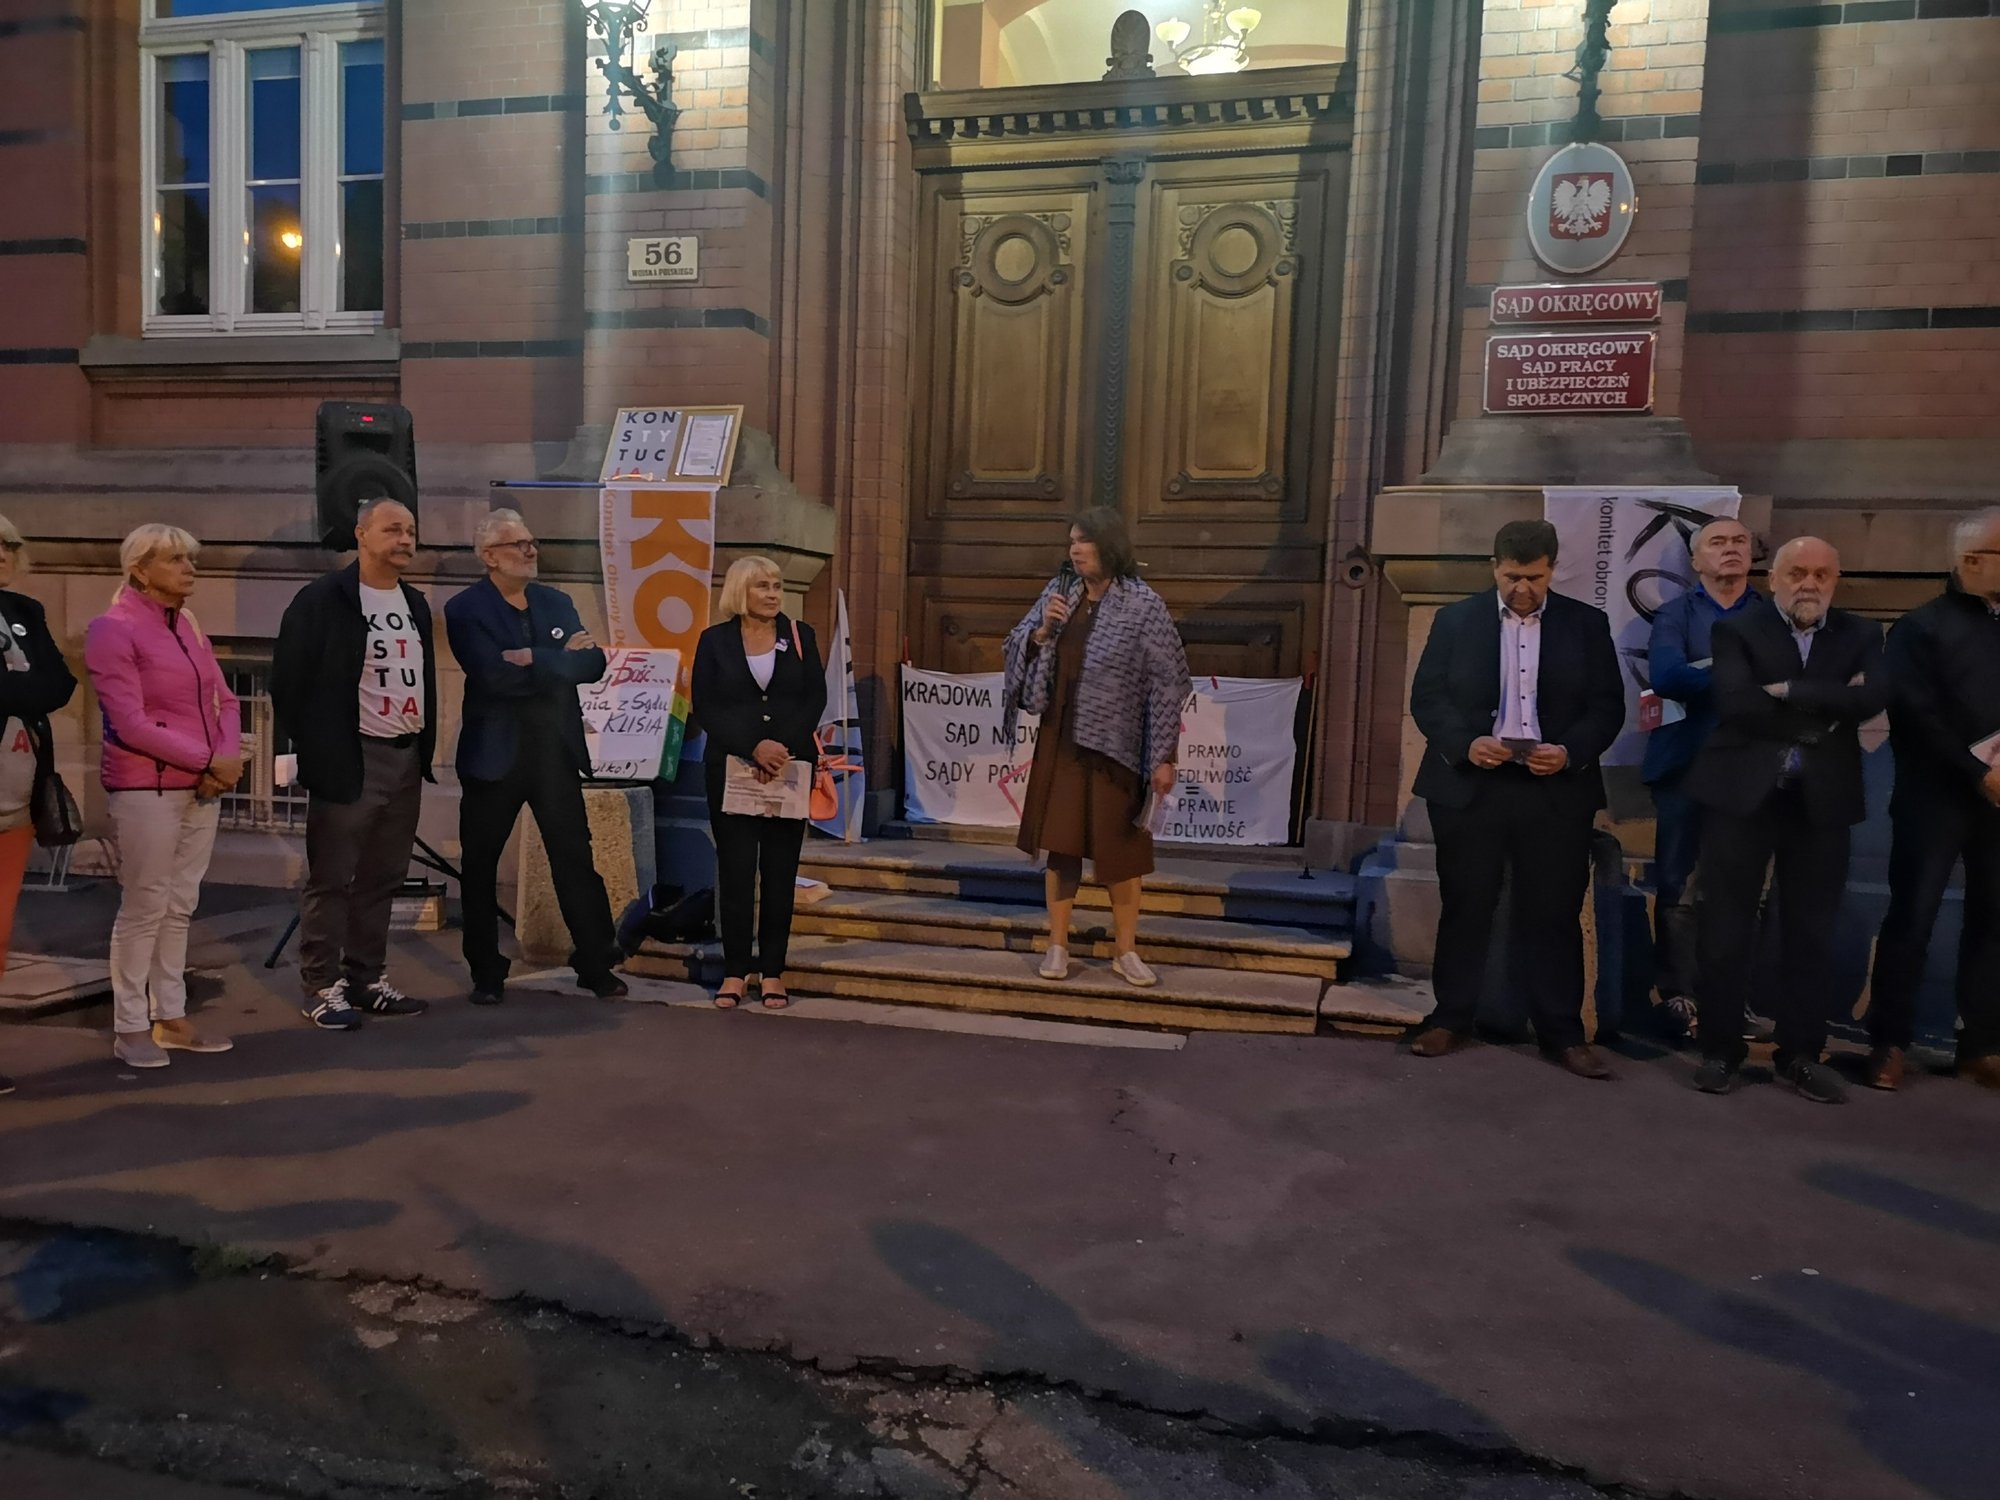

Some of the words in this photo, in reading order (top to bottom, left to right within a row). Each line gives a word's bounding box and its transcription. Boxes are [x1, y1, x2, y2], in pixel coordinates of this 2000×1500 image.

[645, 242, 682, 265] 56
[1497, 297, 1534, 318] SĄD
[1538, 291, 1655, 316] OKRĘGOWY
[1497, 344, 1534, 360] SĄD
[1538, 341, 1644, 358] OKRĘGOWY
[1522, 362, 1556, 376] SĄD
[1560, 360, 1616, 374] PRACY
[1506, 379, 1513, 391] I
[1516, 372, 1630, 390] UBEZPIECZEŃ
[1507, 392, 1627, 406] SPOŁECZNYCH
[626, 411, 676, 424] KON
[622, 430, 671, 442] STY
[619, 449, 666, 461] TUC
[1597, 496, 1619, 556] komitet
[373, 639, 424, 660] ST
[375, 668, 416, 687] TU
[904, 681, 992, 708] KRAJOWA
[378, 696, 418, 716] JA
[945, 722, 980, 747] SĄD
[1188, 745, 1242, 759] PRAWO
[925, 760, 975, 785] SĄDY
[1178, 798, 1236, 814] PRAWIE
